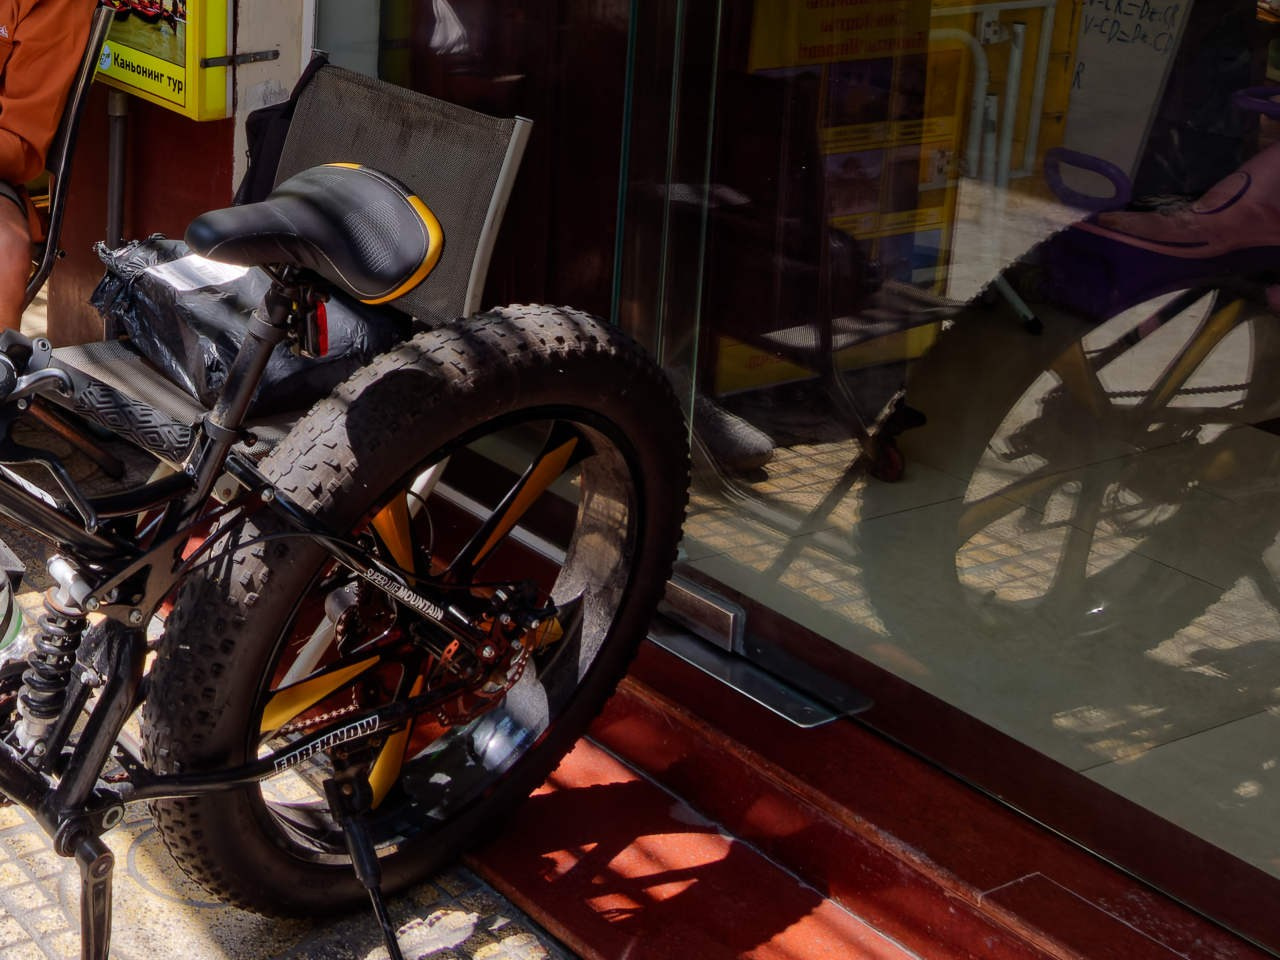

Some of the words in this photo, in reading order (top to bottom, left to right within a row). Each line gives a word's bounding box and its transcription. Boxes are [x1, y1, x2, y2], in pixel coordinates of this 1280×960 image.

[113, 52, 164, 84] Каньонинг
[166, 75, 183, 94] тур
[366, 568, 388, 588] SUPER
[397, 585, 444, 621] MOUNTAIN
[274, 715, 380, 773] FOREKNOW
